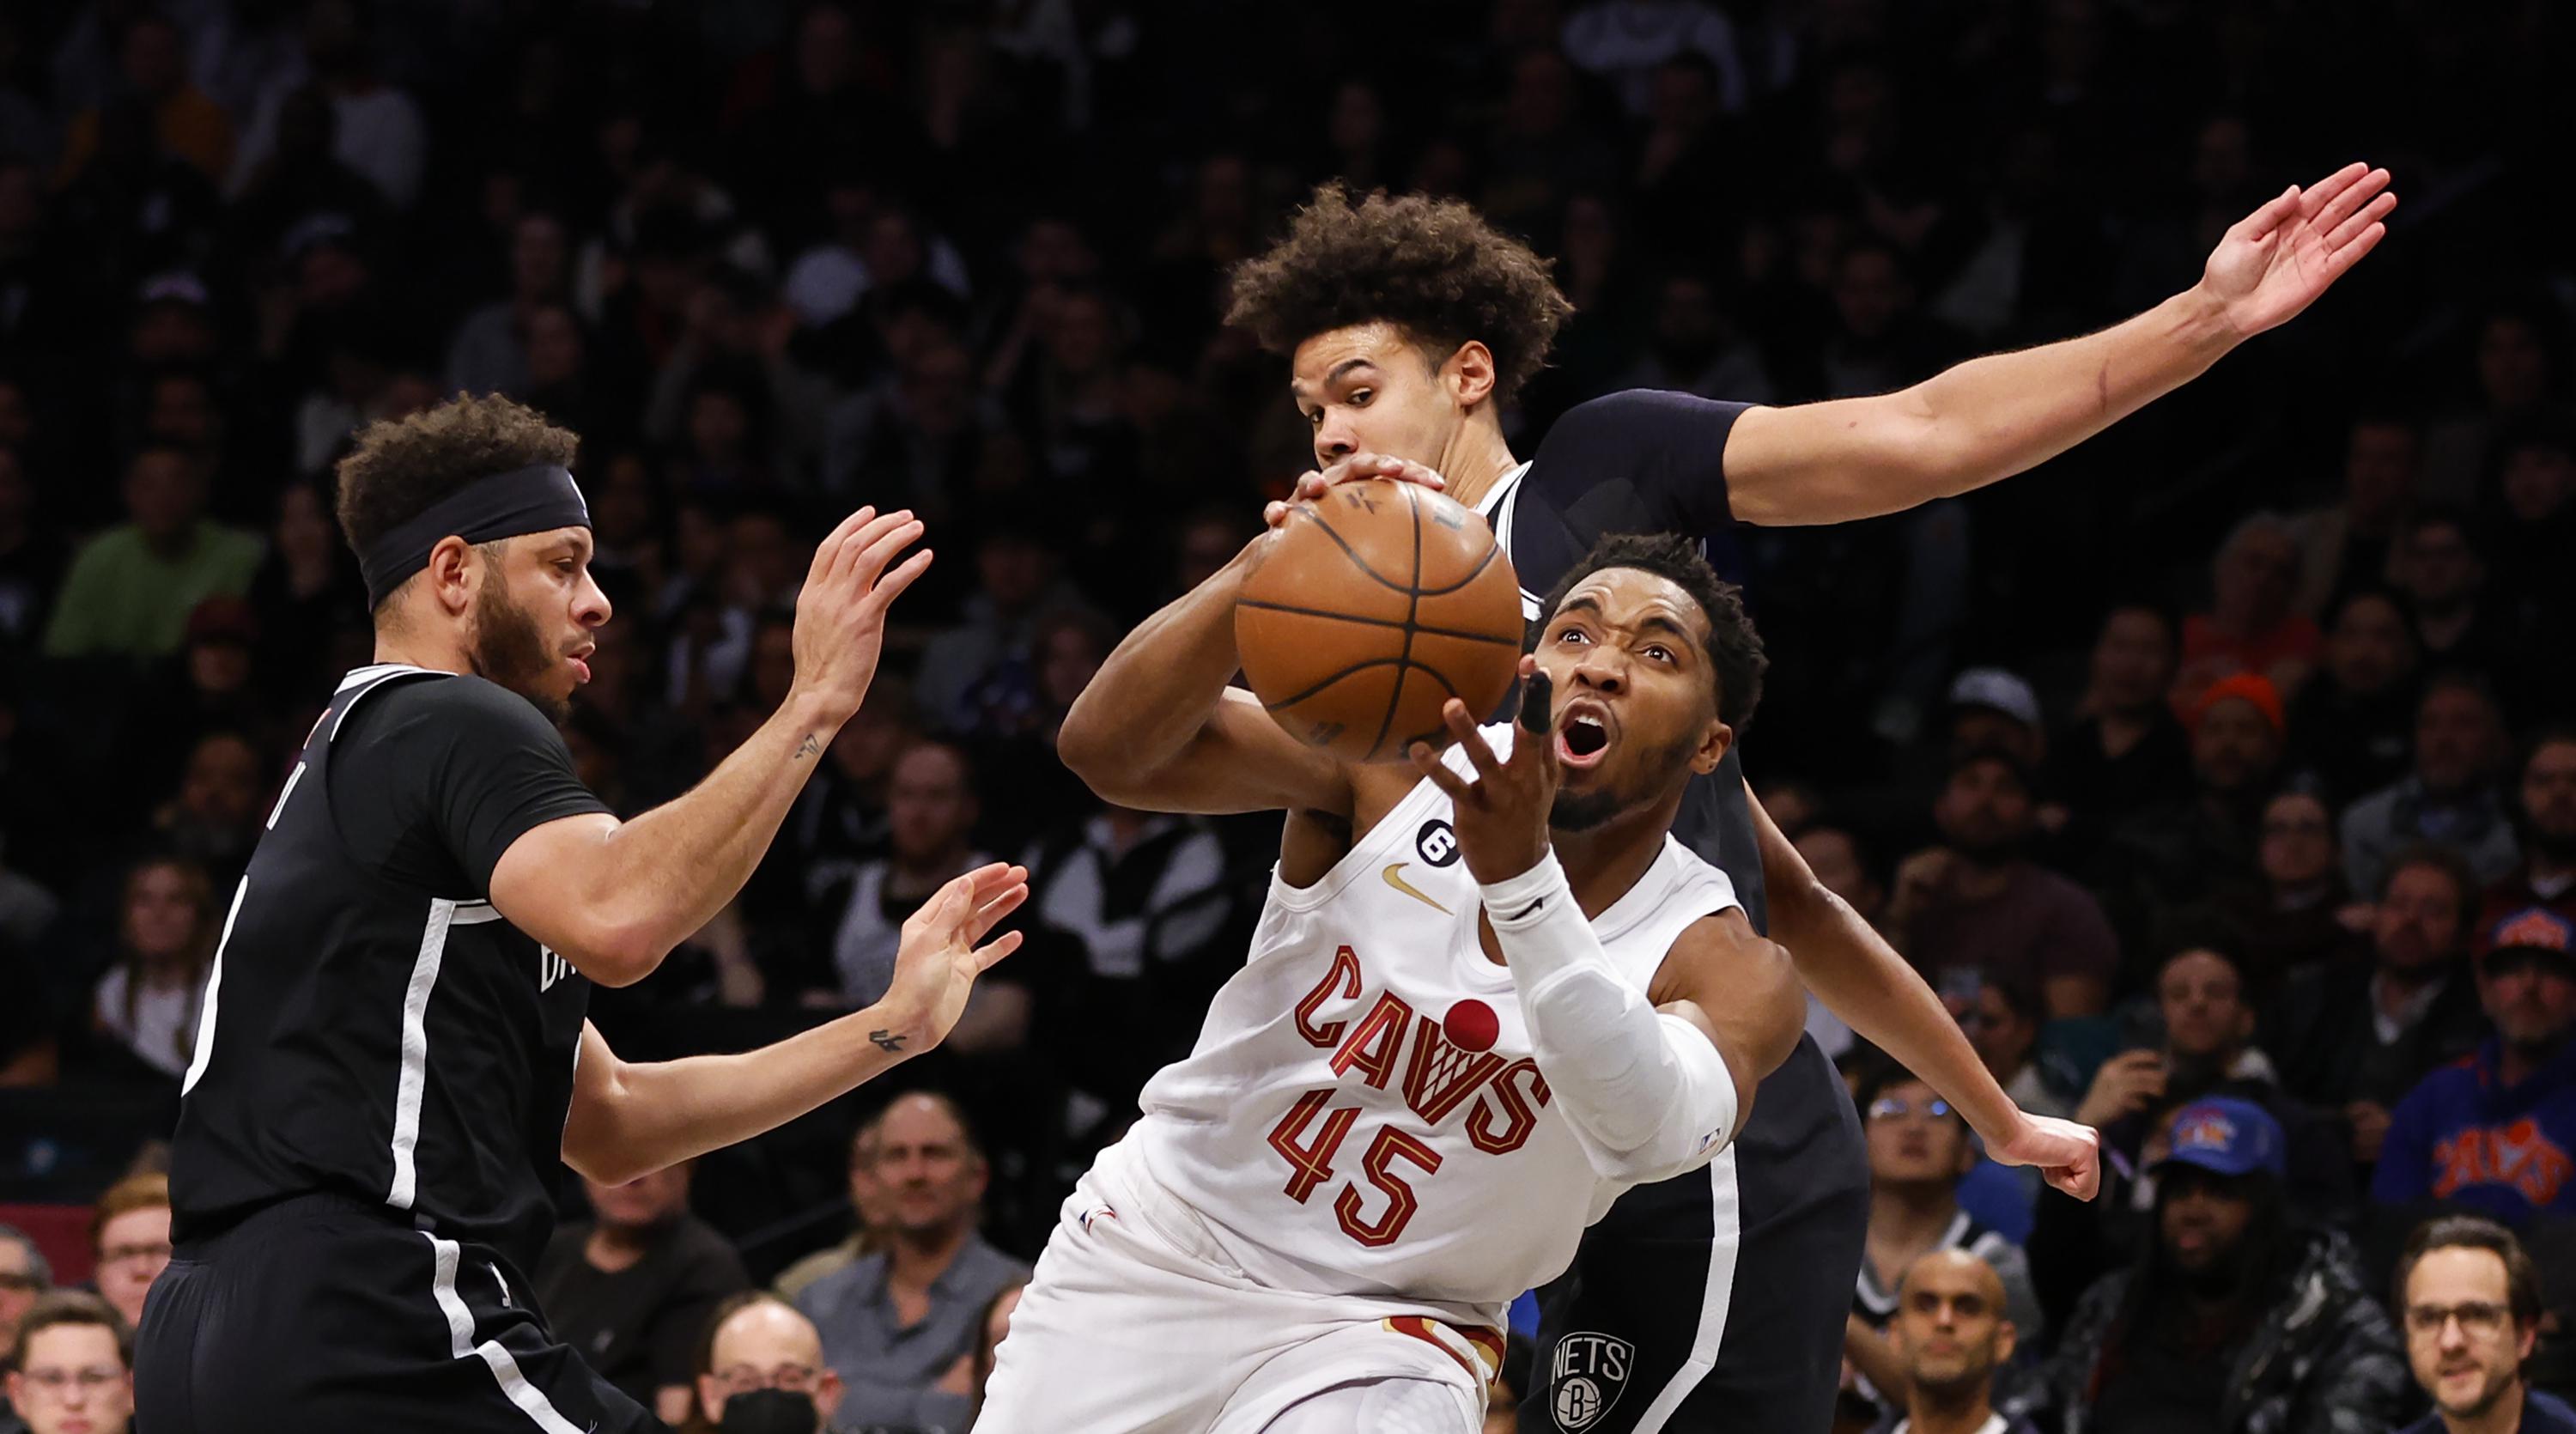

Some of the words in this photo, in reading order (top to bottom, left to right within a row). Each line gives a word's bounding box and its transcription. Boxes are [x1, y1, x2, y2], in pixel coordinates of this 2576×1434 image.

[1421, 826, 1457, 862] 6
[1294, 945, 1552, 1156] CAVS
[1267, 1087, 1444, 1248] 45
[1551, 1337, 1626, 1382] NETS
[1568, 1384, 1585, 1422] B
